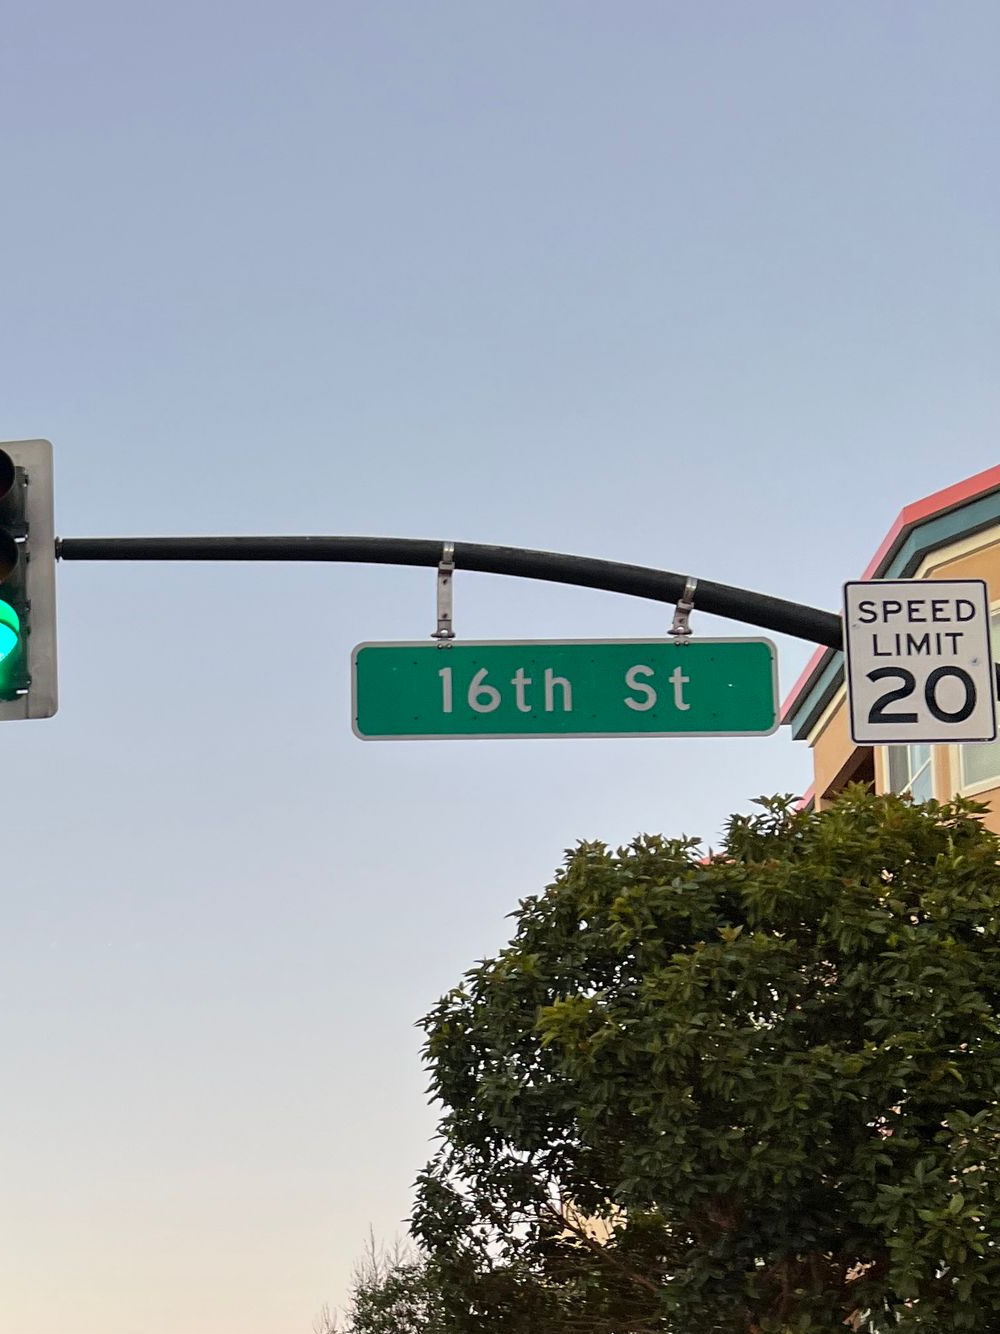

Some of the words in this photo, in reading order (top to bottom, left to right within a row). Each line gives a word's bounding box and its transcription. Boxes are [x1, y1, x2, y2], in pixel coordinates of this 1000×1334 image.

[857, 598, 976, 624] SPEED
[872, 631, 965, 657] LIMIT
[437, 666, 573, 713] 16th
[623, 664, 692, 711] St
[865, 666, 977, 724] 20
